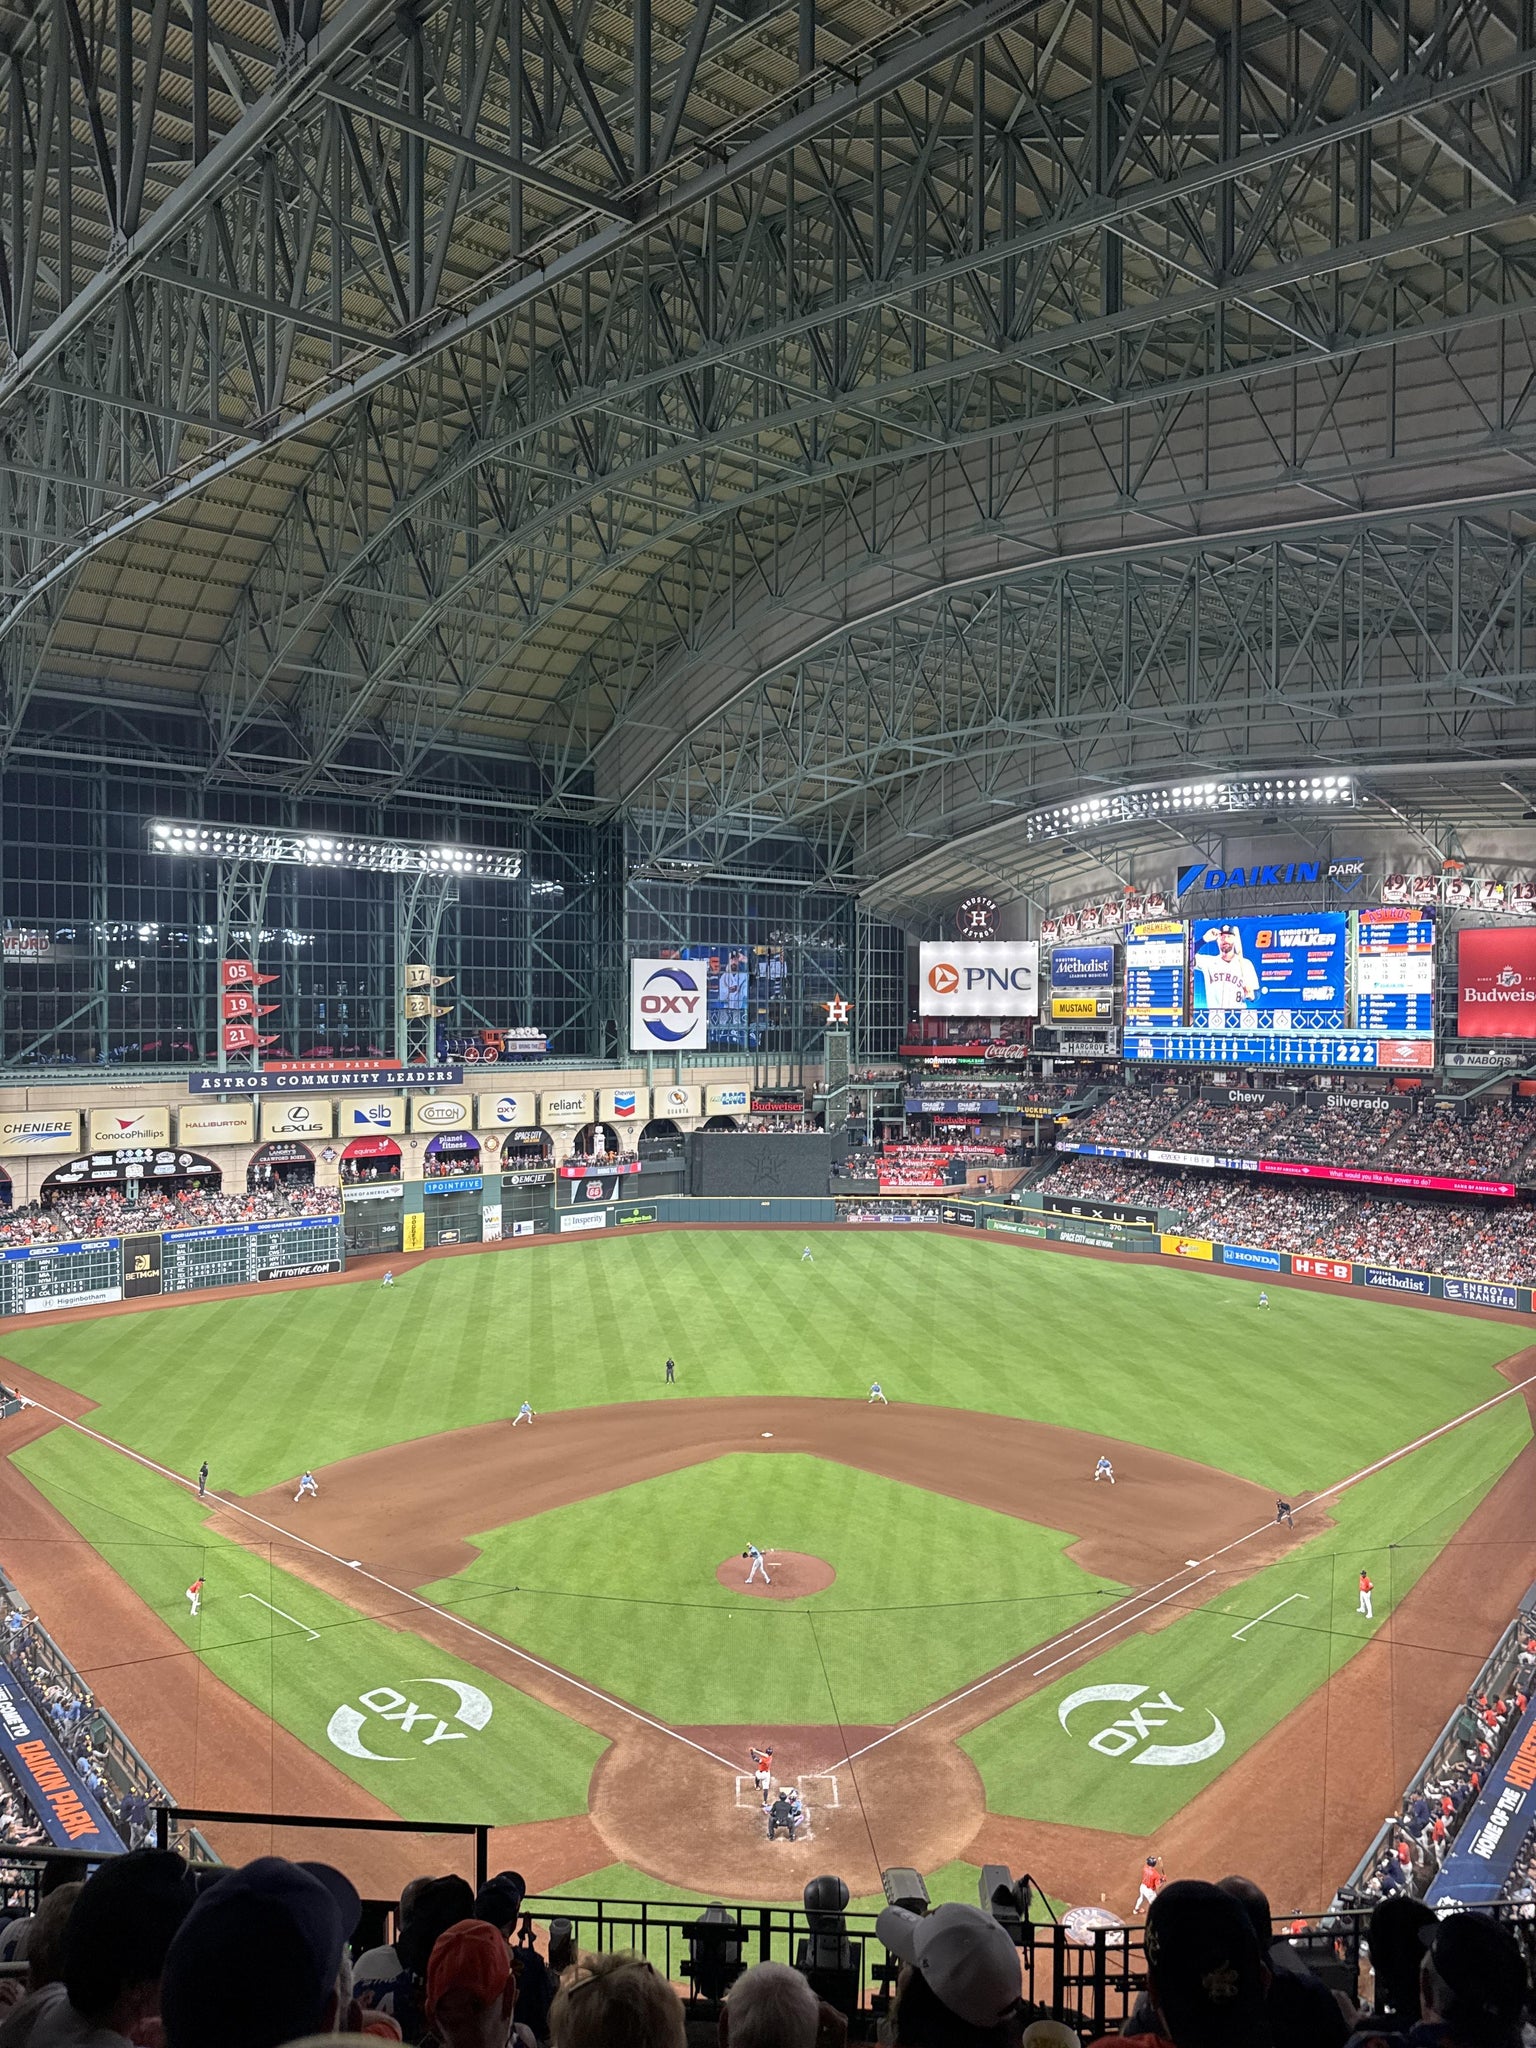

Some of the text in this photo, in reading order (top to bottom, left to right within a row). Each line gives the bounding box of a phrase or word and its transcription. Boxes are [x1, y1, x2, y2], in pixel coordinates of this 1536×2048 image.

[1204, 861, 1365, 890] DAIKIN PARK
[1384, 874, 1404, 891] 49
[1414, 875, 1436, 892] 24
[1452, 878, 1463, 894] 5
[1484, 881, 1495, 897] 7
[961, 896, 997, 910] HOUSTON
[1126, 898, 1141, 911] 34
[1147, 892, 1162, 906] 42
[1083, 908, 1096, 921] 25
[1104, 902, 1117, 916] 33
[1369, 908, 1412, 922] ASTROS
[970, 911, 987, 926] H
[1061, 914, 1076, 927] 40
[963, 927, 994, 938] ASTROS
[1042, 920, 1055, 933] 32
[1143, 923, 1172, 934] BREWERS
[1255, 930, 1273, 948] 8
[1280, 934, 1336, 947] WALKER
[229, 965, 247, 978] 05
[1055, 959, 1108, 973] Methodist
[411, 970, 425, 981] 17
[964, 967, 1031, 990] PNC
[1209, 973, 1243, 988] ASTROS
[1464, 988, 1536, 1002] Budweis
[230, 998, 247, 1010] 19
[411, 1002, 425, 1012] 22
[640, 996, 700, 1014] OXY
[1059, 1003, 1110, 1012] MUSTANG CAT
[827, 1001, 848, 1022] H
[230, 1029, 246, 1041] 21
[1069, 1043, 1109, 1054] HARGROVE
[1336, 1044, 1348, 1062] 2
[1349, 1044, 1360, 1062] 2
[1363, 1045, 1374, 1062] 2
[1467, 1056, 1511, 1065] NABORS
[201, 1071, 453, 1089] ASTROS COMMUNITY LEADERS
[549, 1099, 583, 1110] reliant
[721, 1092, 746, 1105] LNG
[1229, 1090, 1389, 1110] Chevy Silverado
[369, 1105, 392, 1119] slb
[752, 1101, 803, 1112] Budweiser
[424, 1107, 459, 1120] COTTON
[933, 1115, 982, 1125] Budweiser
[3, 1122, 72, 1134] CHENIERE
[185, 1120, 247, 1129] HALLIBURTON
[272, 1124, 323, 1133] LEXUS
[95, 1130, 165, 1141] ConocoPhillips
[439, 1135, 463, 1144] planet
[514, 1131, 531, 1143] SPACE
[530, 1130, 543, 1140] CITY
[442, 1141, 467, 1149] fitness
[1184, 1155, 1211, 1164] FIBER
[519, 1174, 546, 1184] EMCJET
[1345, 1171, 1361, 1179] would
[1373, 1173, 1383, 1181] like
[1394, 1177, 1412, 1185] power
[428, 1180, 480, 1191] 1POINTFIVE
[572, 1214, 602, 1225] Insperity
[1052, 1203, 1147, 1223] LEXUS
[1109, 1224, 1121, 1232] 370
[1060, 1231, 1075, 1242] SPACE
[1075, 1233, 1086, 1243] CITY
[29, 1247, 59, 1255] GEICO
[81, 1241, 110, 1250] GEICO
[1235, 1253, 1278, 1265] HONDA
[126, 1269, 160, 1281] BETMGM
[269, 1264, 330, 1279] NITTOTIRE.COM
[1369, 1275, 1424, 1291] Methodist
[1463, 1283, 1504, 1295] ENERGY
[57, 1294, 106, 1306] Higginbotham
[1463, 1291, 1515, 1306] TRANSFER
[358, 1687, 469, 1746] OXY
[12, 1722, 31, 1738] TO
[1087, 1690, 1185, 1757] OXY
[15, 1739, 100, 1841] DAIKIN PARK
[1474, 1787, 1521, 1860] HOME OF THE
